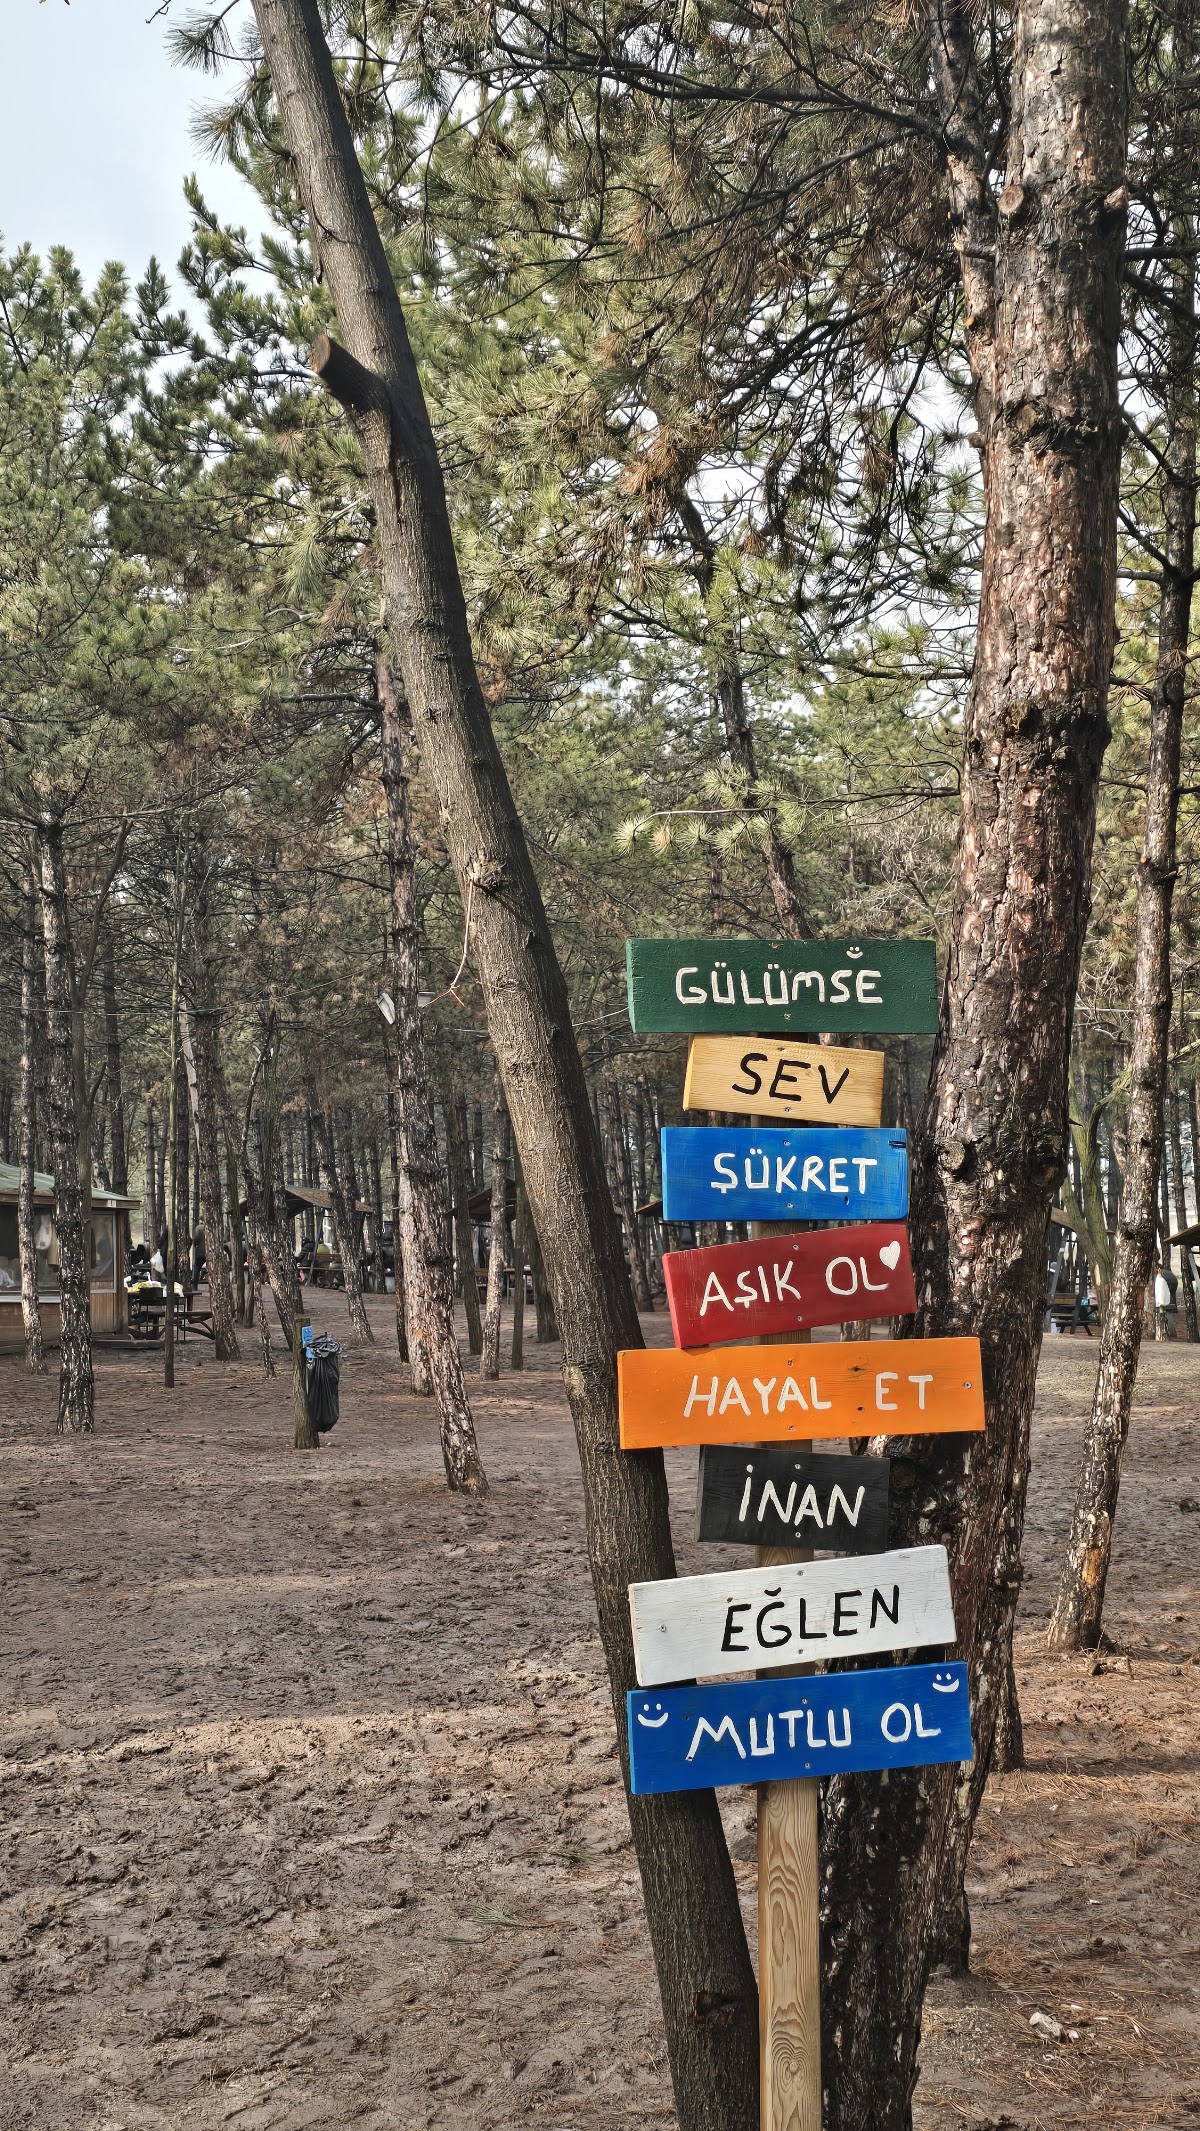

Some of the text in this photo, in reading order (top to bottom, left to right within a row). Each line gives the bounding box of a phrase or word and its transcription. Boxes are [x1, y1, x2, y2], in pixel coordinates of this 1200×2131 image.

[731, 1052, 850, 1104] SEV
[710, 1148, 878, 1194] ŞÜKRET
[699, 1256, 889, 1317] AŞIK OL
[683, 1371, 934, 1417] HAYAL ET
[738, 1464, 866, 1529] İNAN
[720, 1584, 900, 1652] EĞLEN
[685, 1702, 942, 1762] MUTLU OL
